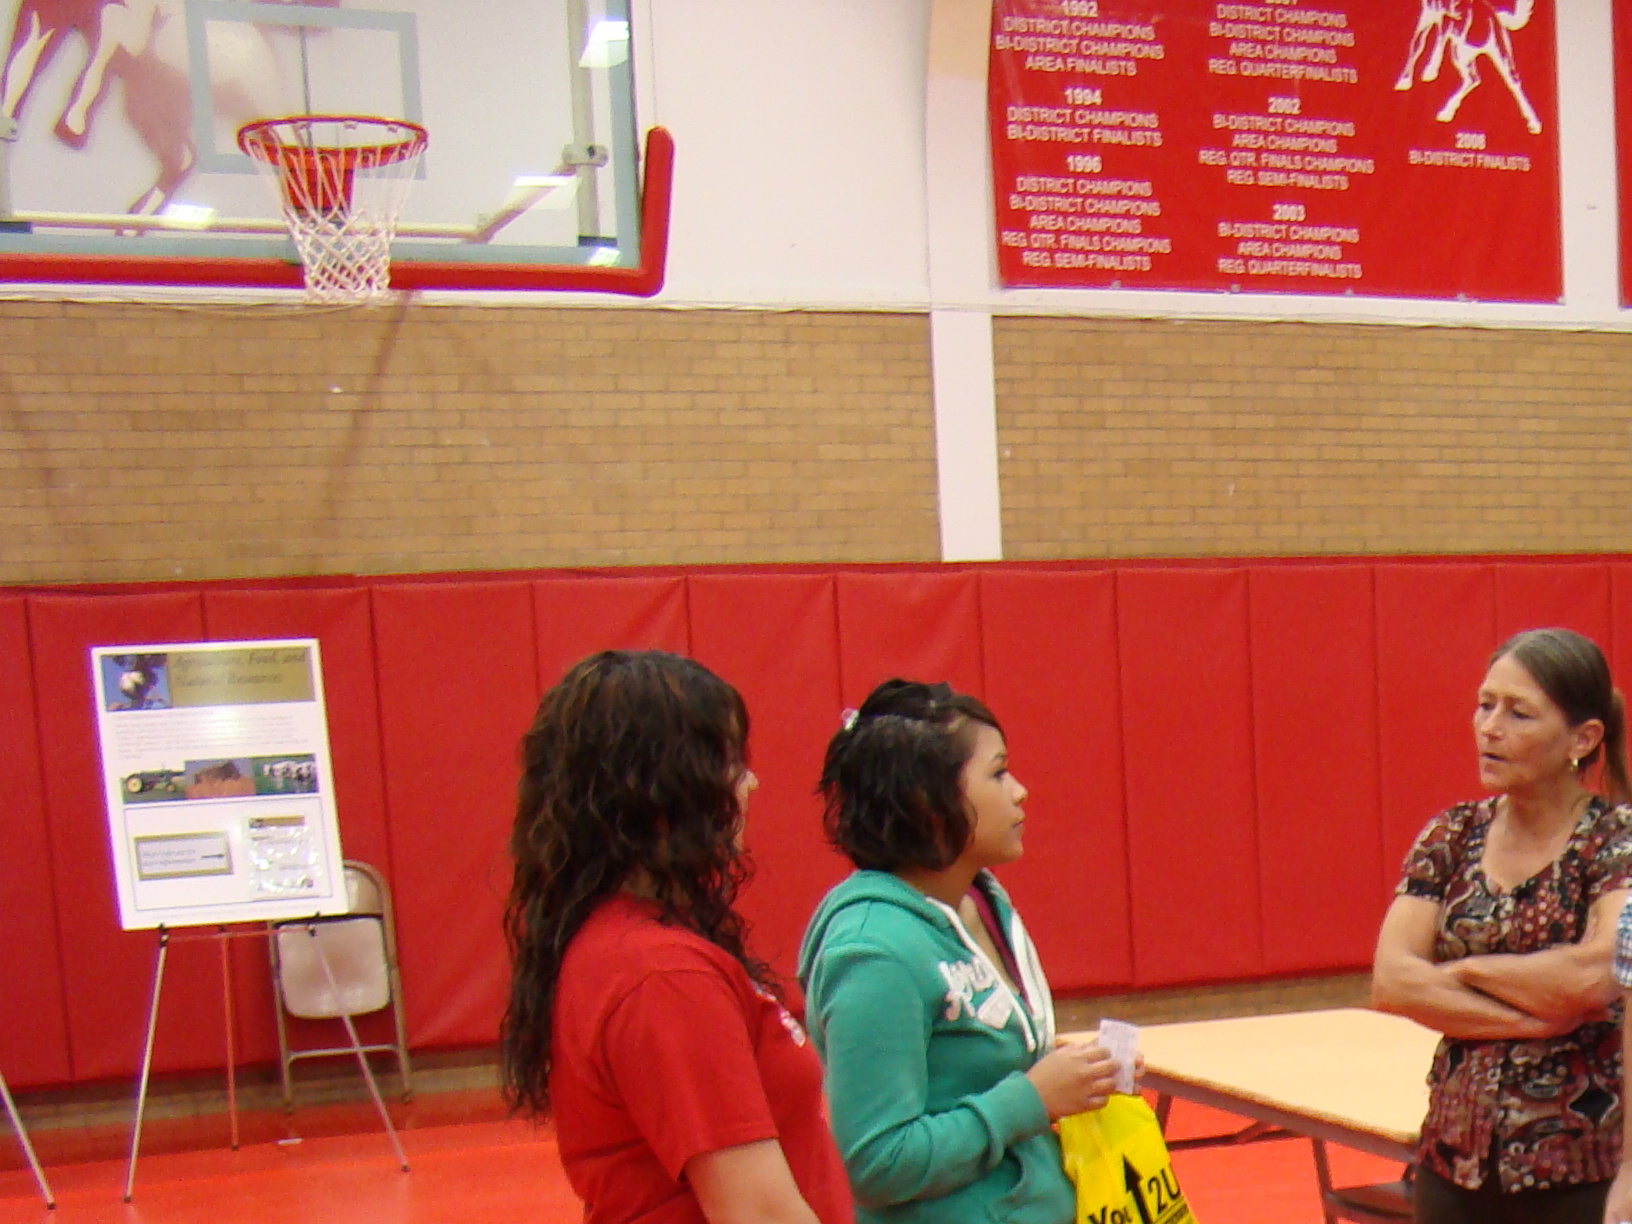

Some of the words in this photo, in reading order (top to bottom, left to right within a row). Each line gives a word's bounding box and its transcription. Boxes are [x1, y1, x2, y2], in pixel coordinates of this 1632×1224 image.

[1062, 0, 1098, 17] 1992
[1217, 4, 1273, 22] DISTRICT
[1275, 9, 1348, 28] CHAMPIONS
[1003, 16, 1071, 35] DISTRICT
[1071, 20, 1156, 41] CHAMPIONS
[1209, 21, 1281, 41] BI-DISTRICT
[1283, 27, 1355, 48] CHAMPIONS
[996, 34, 1080, 53] BI-DISTRICT
[1080, 39, 1165, 60] CHAMPIONS
[1229, 41, 1263, 58] AREA
[1264, 46, 1337, 64] CHAMPIONS
[1025, 56, 1064, 71] AREA
[1066, 57, 1137, 76] FINALISTS
[1239, 61, 1358, 84] QUARTERFINALISTS
[1064, 87, 1103, 106] 1994
[1006, 105, 1073, 123] DISTRICT
[1074, 109, 1159, 128] CHAMPIONS
[1213, 113, 1283, 131] BI-DISTRICT
[1285, 118, 1356, 137] CHAMPIONS
[1006, 124, 1091, 143] BI-DISTRICT
[1093, 129, 1163, 147] FINALISTS
[1232, 133, 1265, 148] AREA
[1267, 135, 1338, 153] CHAMPIONS
[1260, 152, 1303, 170] FINALS
[1304, 156, 1375, 174] CHAMPIONS
[1408, 150, 1474, 168] BI-DISTRICT
[1476, 154, 1531, 172] FINALISTS
[1016, 176, 1075, 193] DISTRICT
[1076, 179, 1153, 197] CHAMPIONS
[1257, 171, 1350, 191] SEMI-FINALISTS
[1009, 195, 1084, 212] BI-DISTRICT
[1084, 198, 1162, 217] CHAMPIONS
[1030, 215, 1065, 230] AREA
[1067, 217, 1142, 235] CHAMPIONS
[1217, 221, 1288, 239] BI-DISTRICT
[1289, 226, 1360, 244] CHAMPIONS
[1060, 234, 1101, 251] FINALS
[1102, 236, 1172, 254] CHAMPIONS
[1237, 241, 1271, 257] AREA
[1272, 243, 1343, 260] CHAMPIONS
[1054, 252, 1152, 271] SEMI-FINALISTS
[1248, 260, 1363, 279] QUARTERFINALISTS
